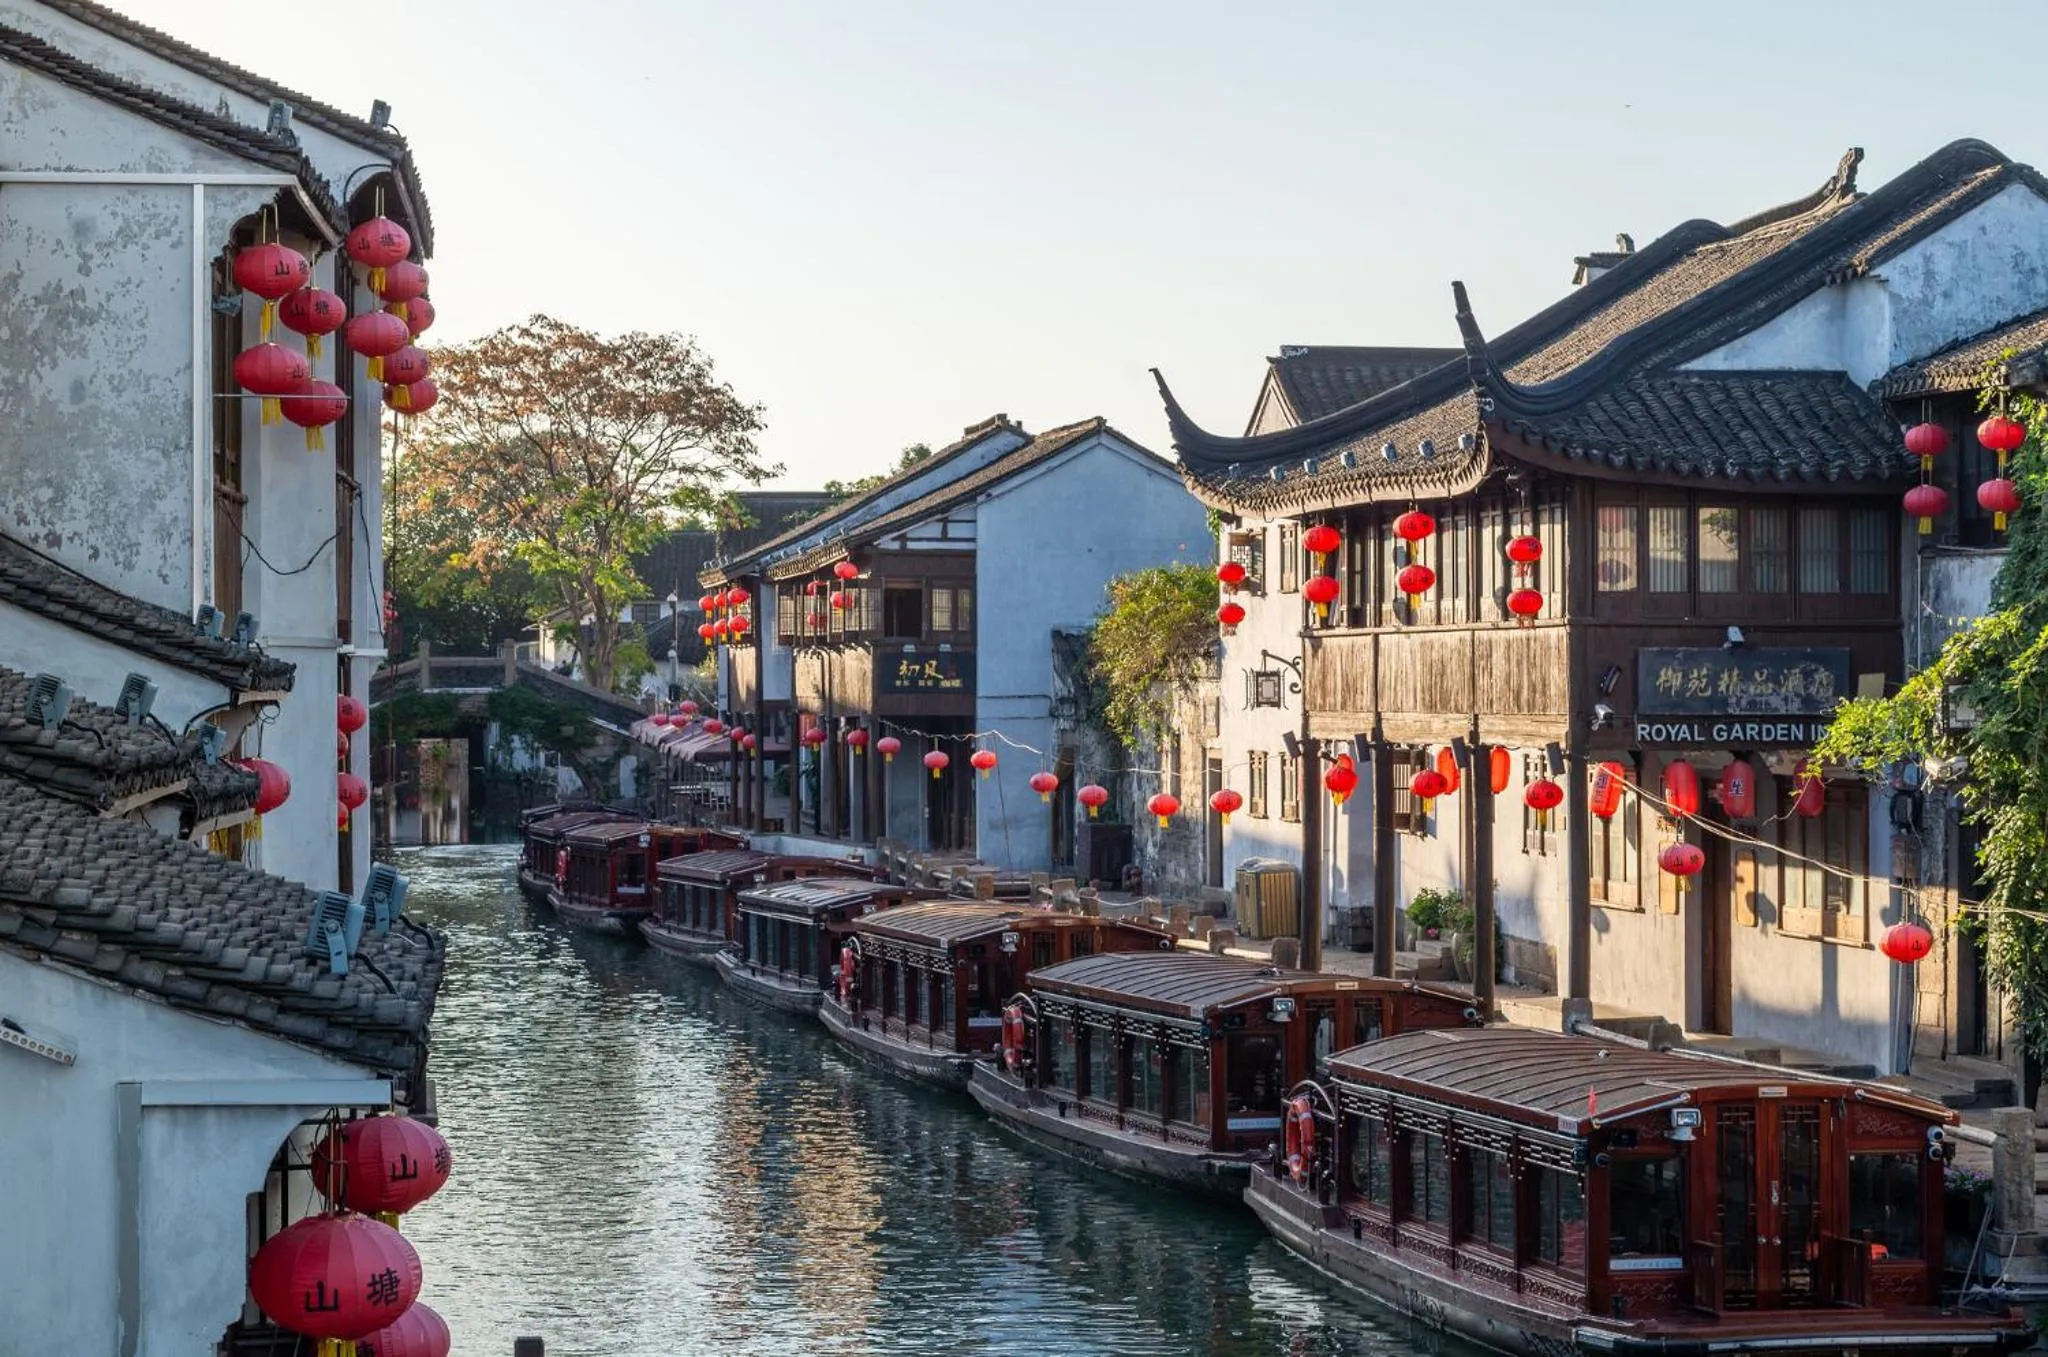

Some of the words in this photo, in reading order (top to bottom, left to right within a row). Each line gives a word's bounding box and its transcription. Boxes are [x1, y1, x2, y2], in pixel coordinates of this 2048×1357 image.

[1637, 723, 1705, 742] ROYAL
[1712, 723, 1803, 742] GARDEN
[305, 1267, 400, 1313] 山塘
